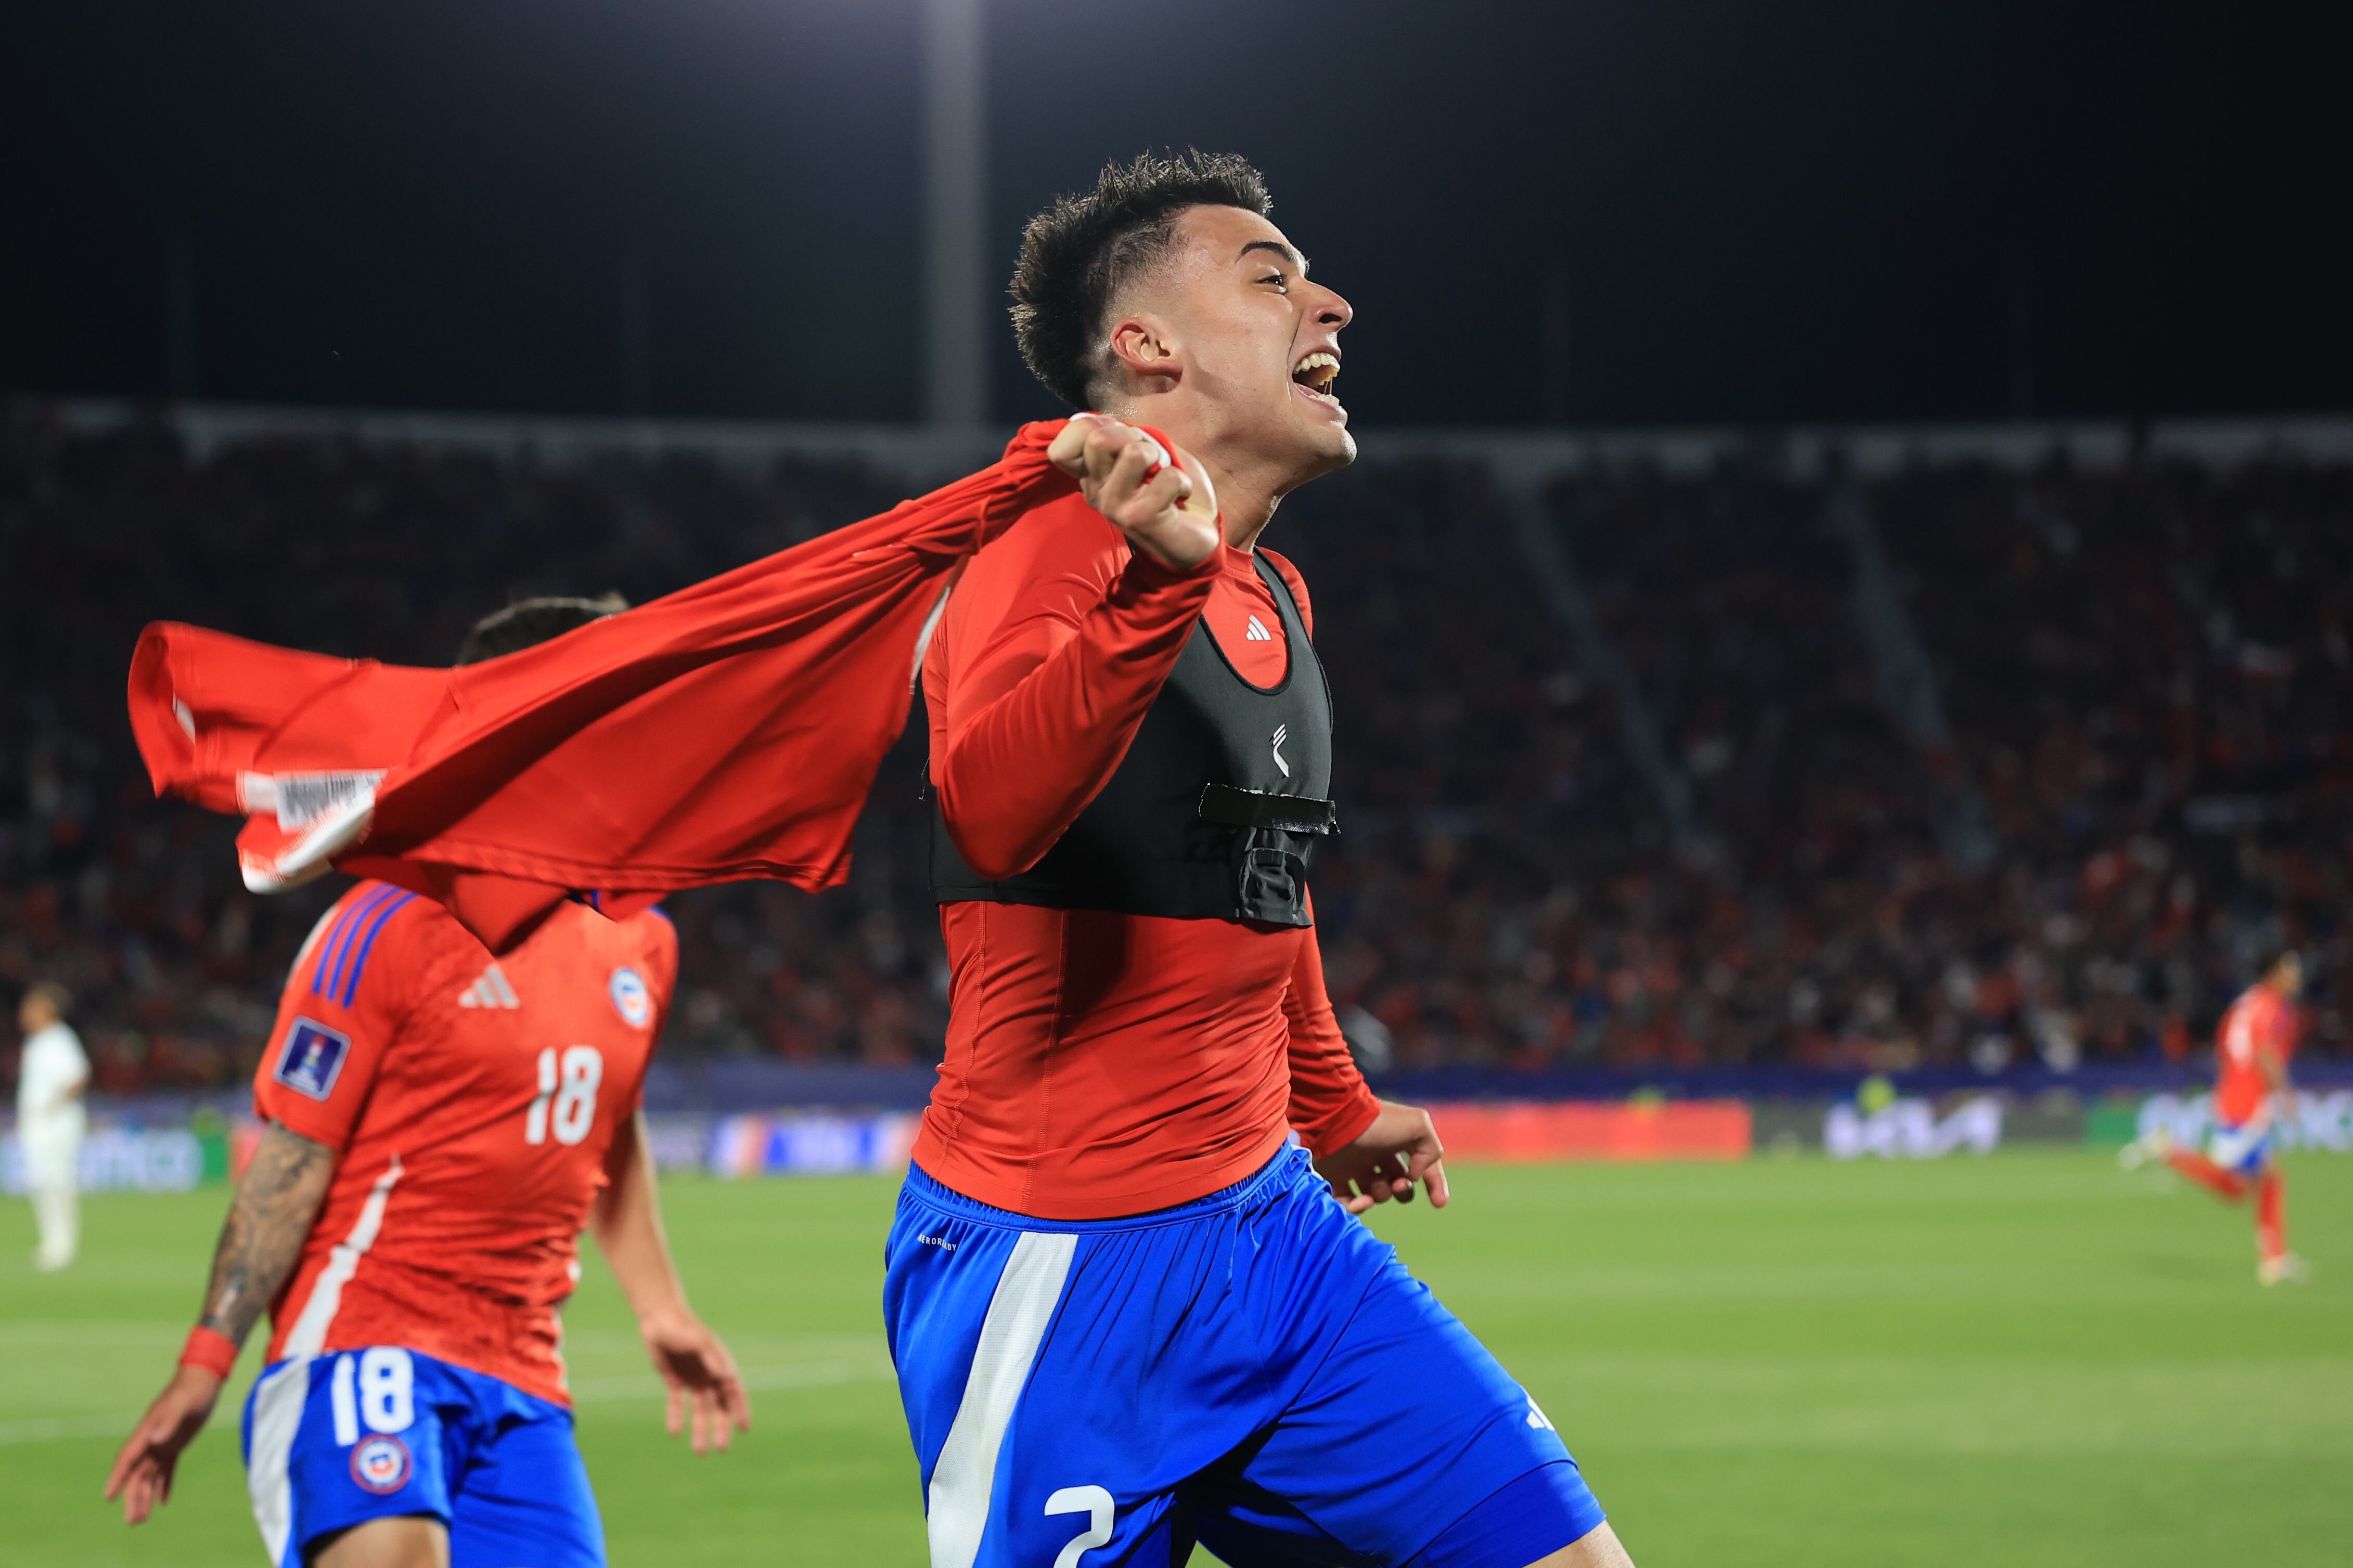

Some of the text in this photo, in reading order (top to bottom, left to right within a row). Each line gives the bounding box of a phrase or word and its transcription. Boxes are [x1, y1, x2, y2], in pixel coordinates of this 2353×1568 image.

[525, 1044, 603, 1145] 18
[917, 1233, 957, 1251] AEROREADY
[331, 1346, 415, 1447] 18
[1044, 1485, 1115, 1568] 2
